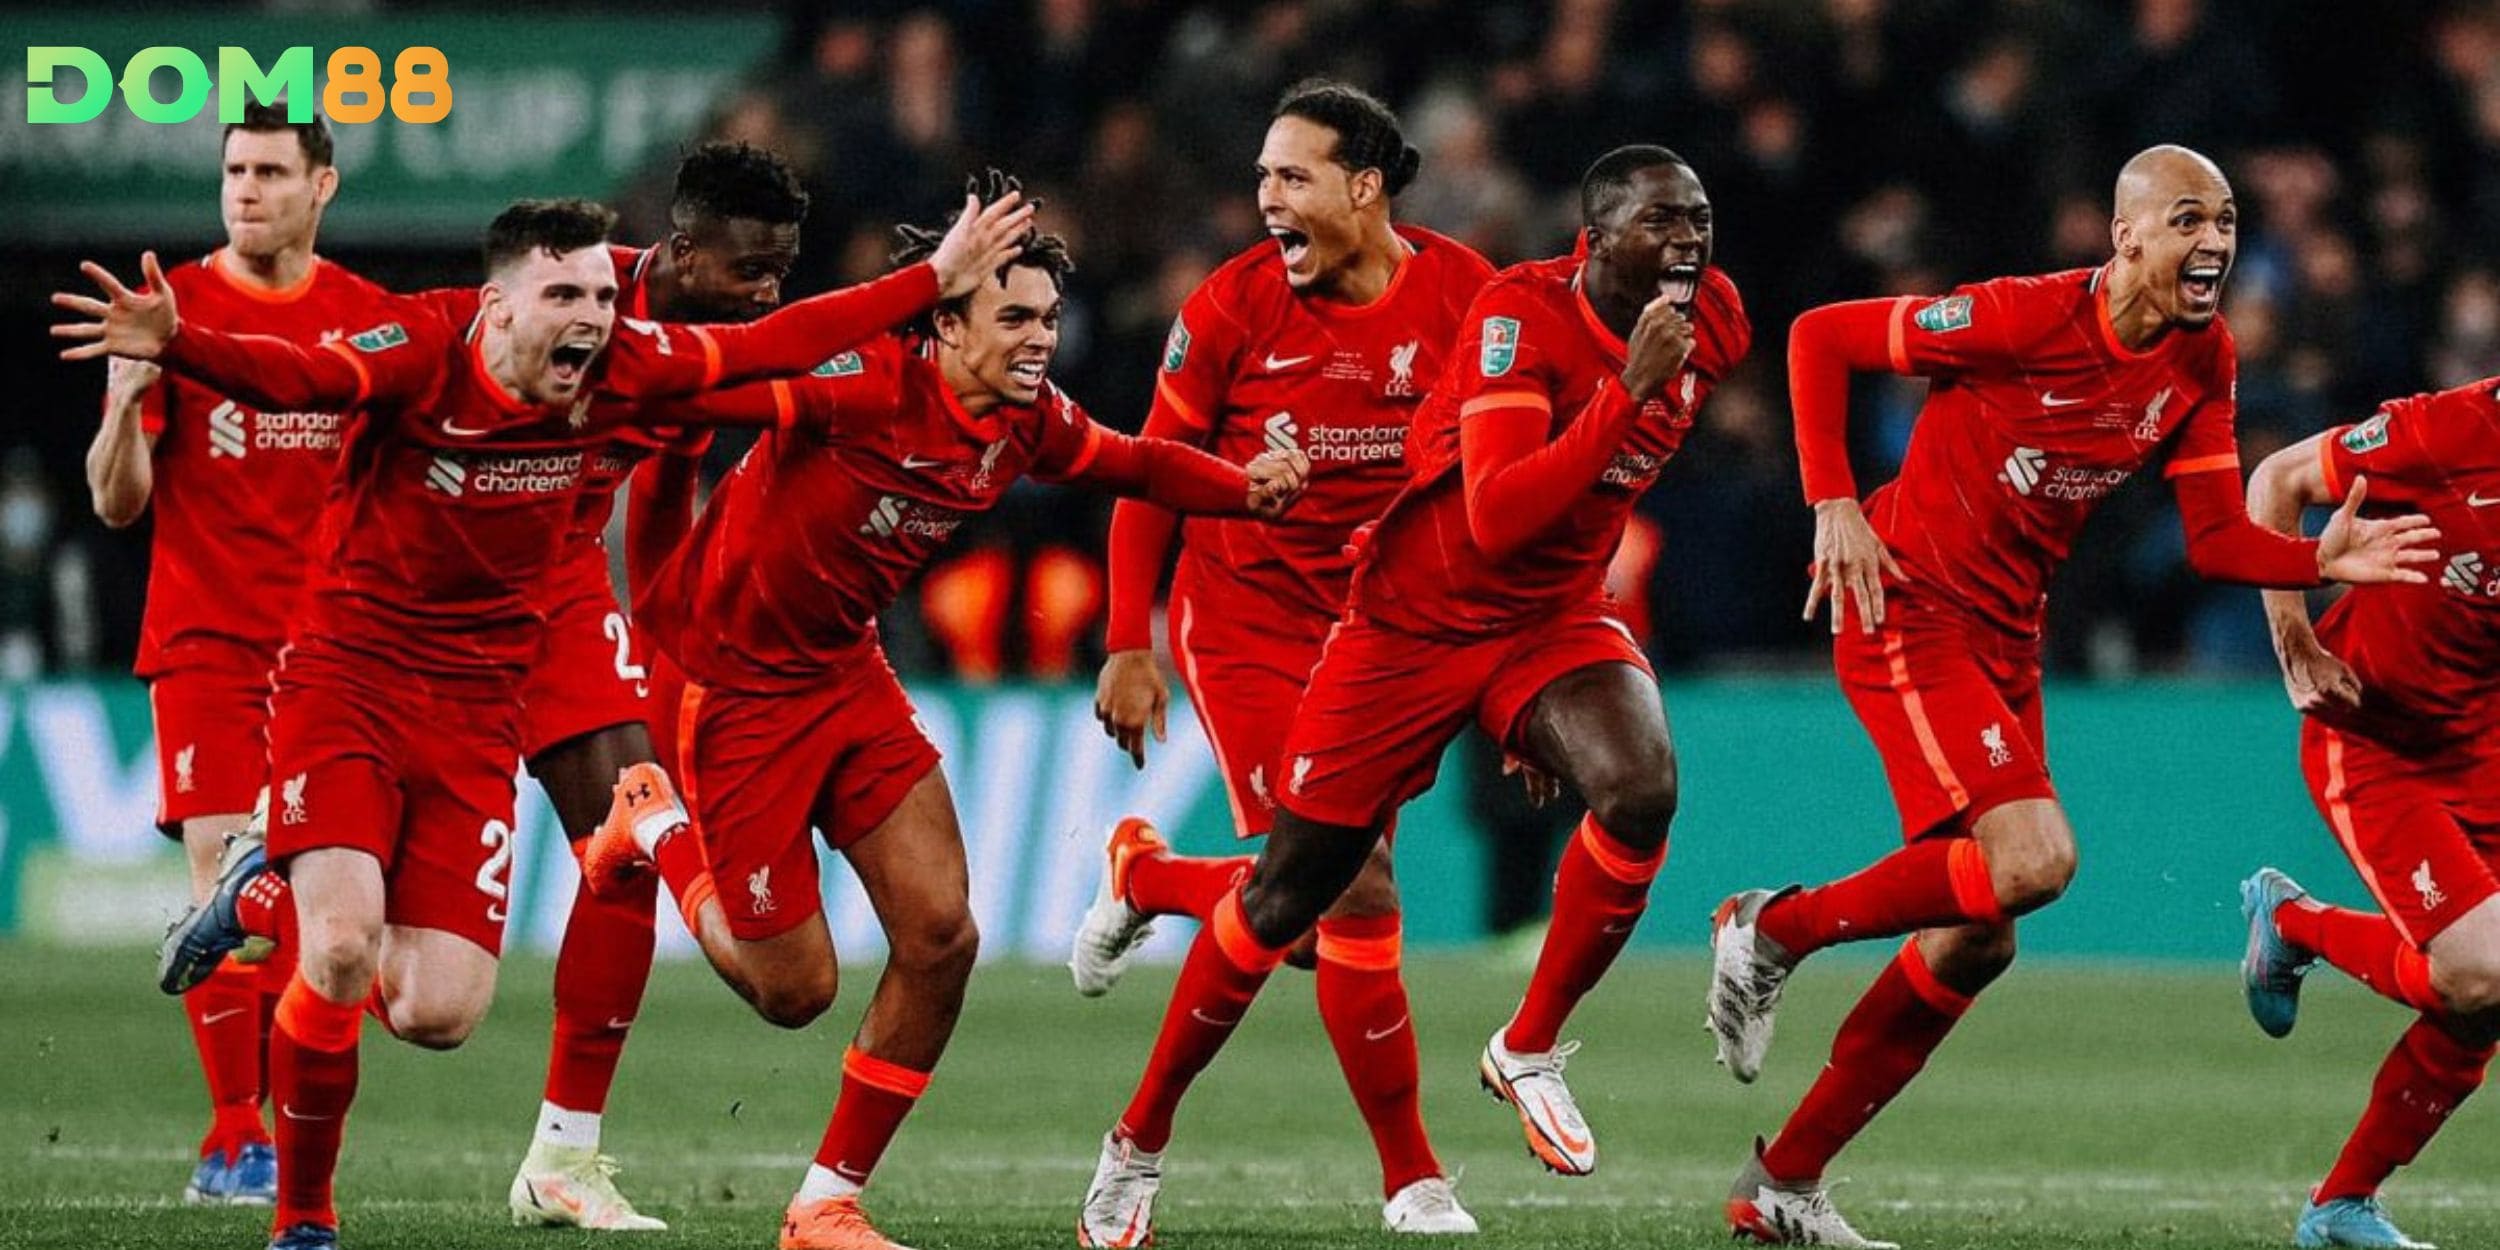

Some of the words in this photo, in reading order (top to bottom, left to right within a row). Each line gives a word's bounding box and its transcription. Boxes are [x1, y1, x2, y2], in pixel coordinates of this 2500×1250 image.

[1384, 380, 1414, 396] LFC
[255, 412, 341, 429] standar
[1308, 442, 1404, 463] chartere
